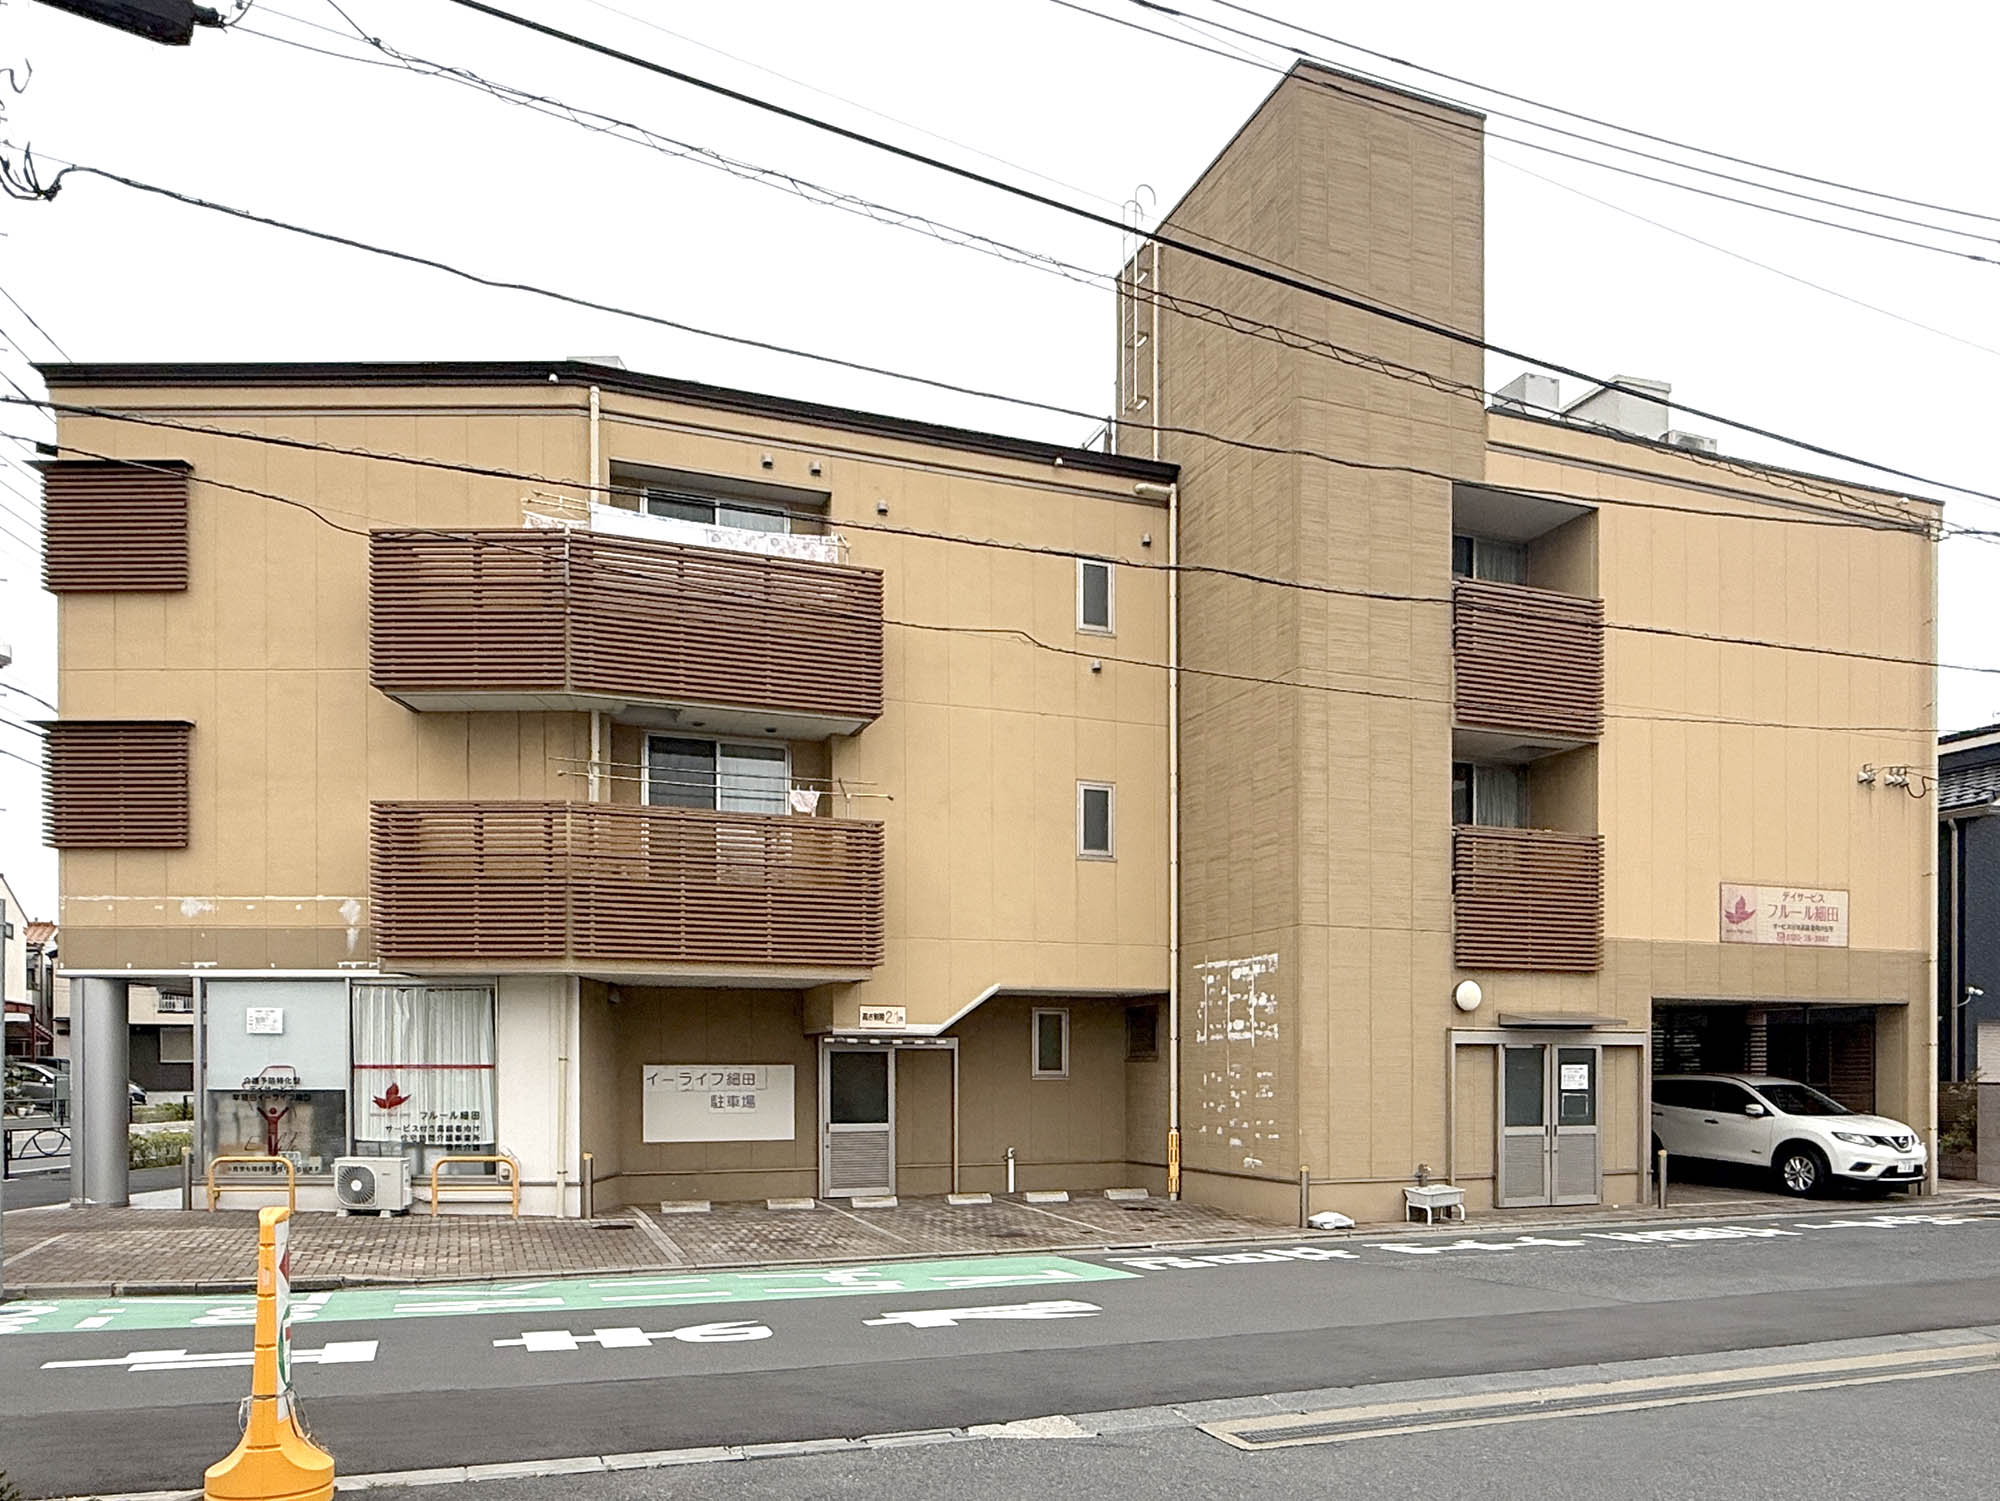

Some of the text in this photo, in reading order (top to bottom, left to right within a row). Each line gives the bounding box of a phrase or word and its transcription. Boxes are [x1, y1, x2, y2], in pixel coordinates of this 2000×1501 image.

[1782, 891, 1825, 904] デイサービス
[1767, 904, 1839, 922] フルール細田
[646, 1071, 756, 1087] イーライフ細田
[710, 1094, 756, 1109] 駐車場
[419, 1110, 480, 1120] フルール細田
[40, 1299, 1103, 1372] 止まれ
